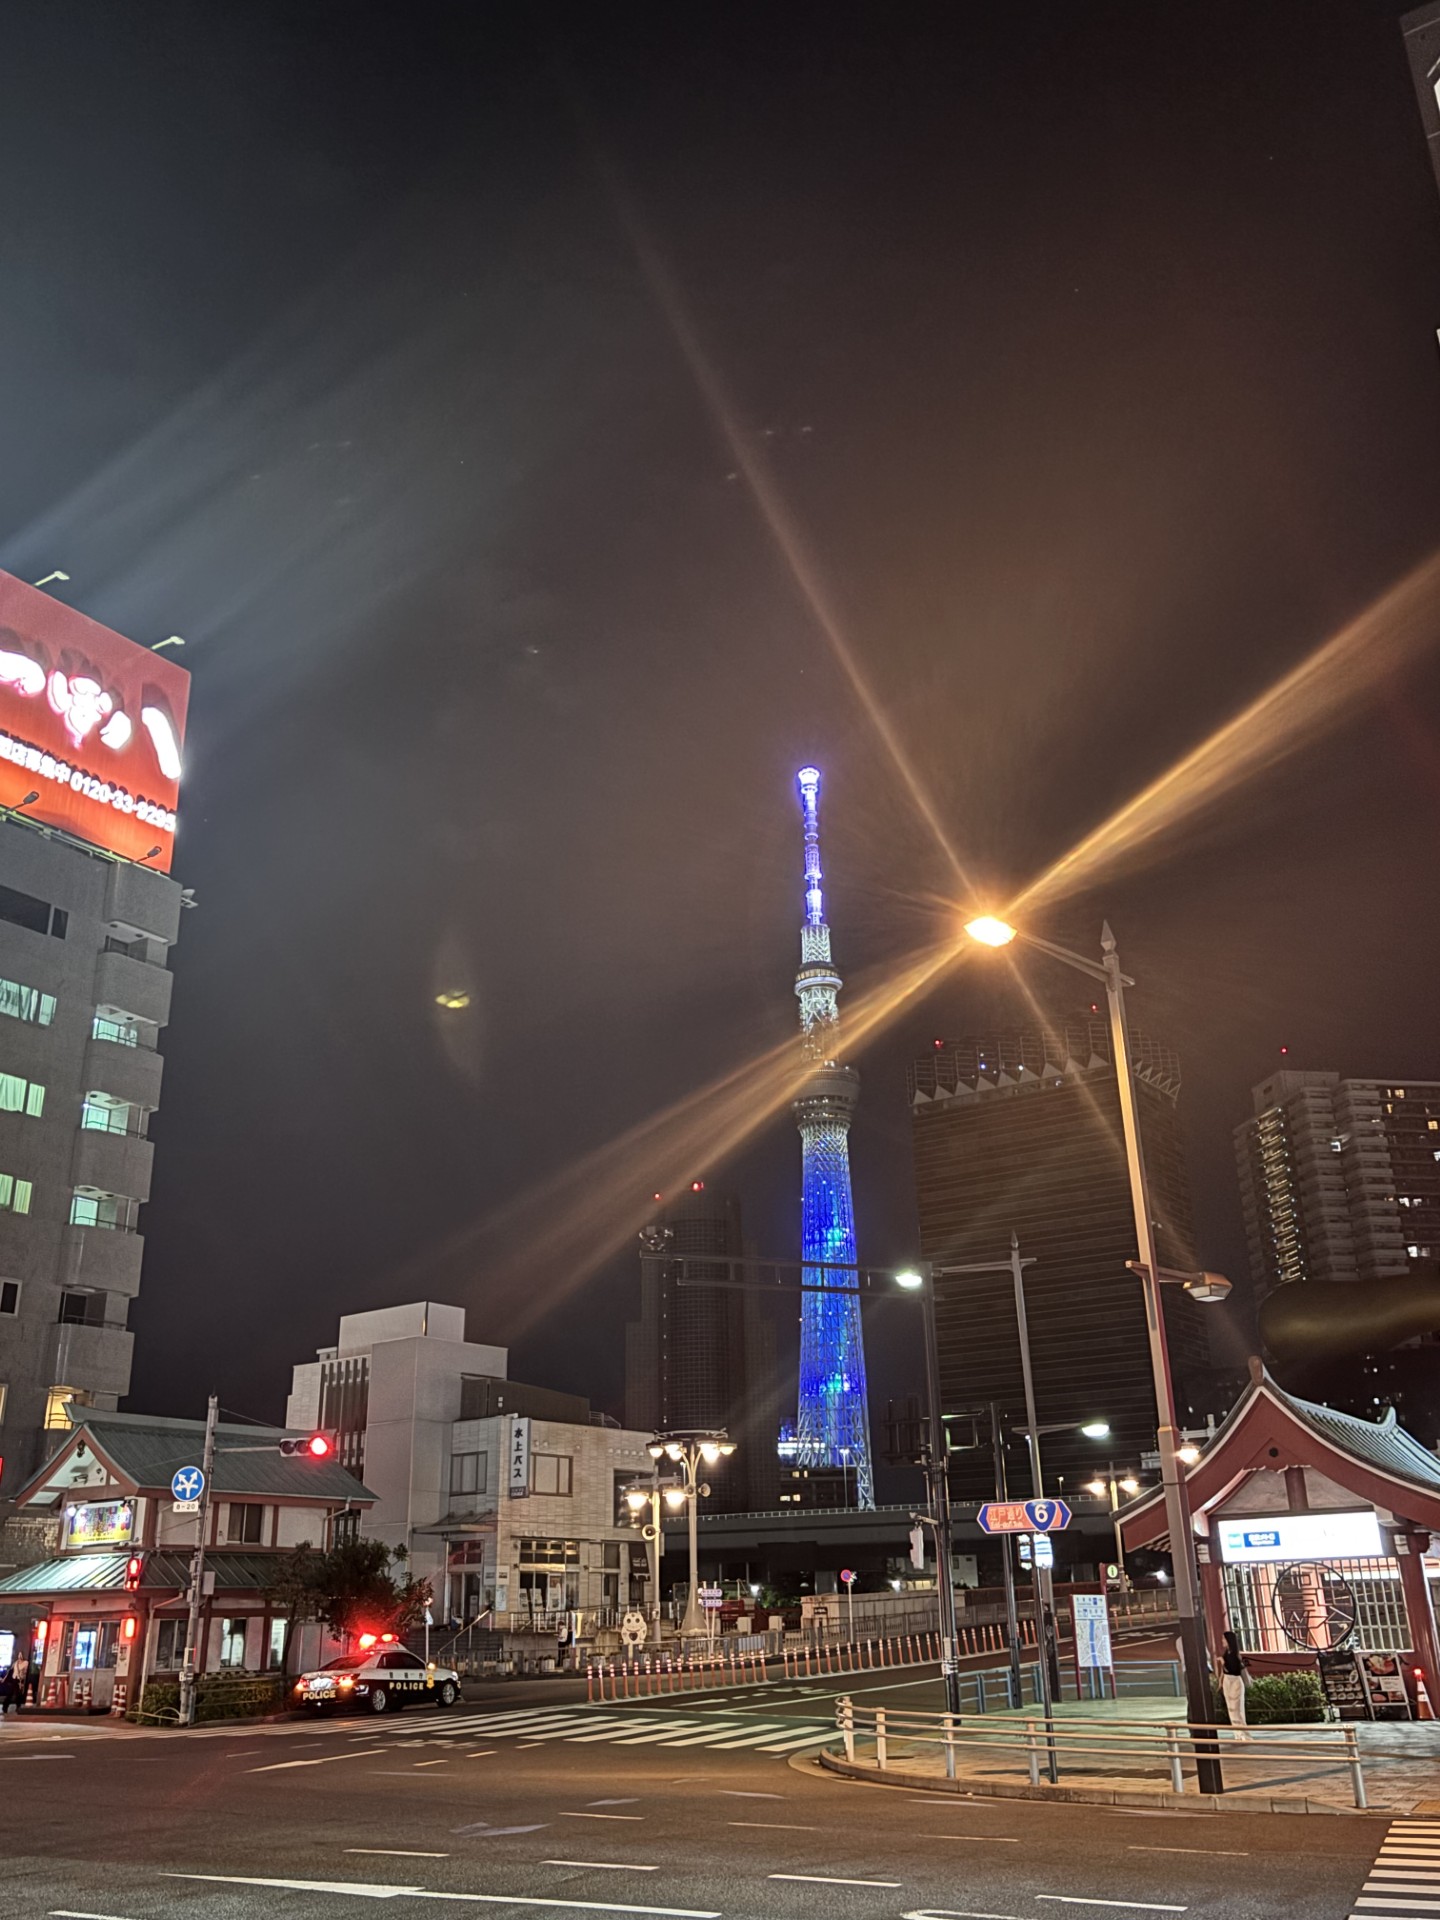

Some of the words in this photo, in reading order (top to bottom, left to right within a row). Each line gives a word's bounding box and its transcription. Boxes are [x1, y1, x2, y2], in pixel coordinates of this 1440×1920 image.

[513, 1427, 524, 1479] 水上バス
[176, 1503, 196, 1511] 8-20
[1034, 1503, 1049, 1524] 6
[990, 1506, 1023, 1522] 江戸通り
[389, 1681, 424, 1691] POLICE
[302, 1690, 337, 1700] POLICE
